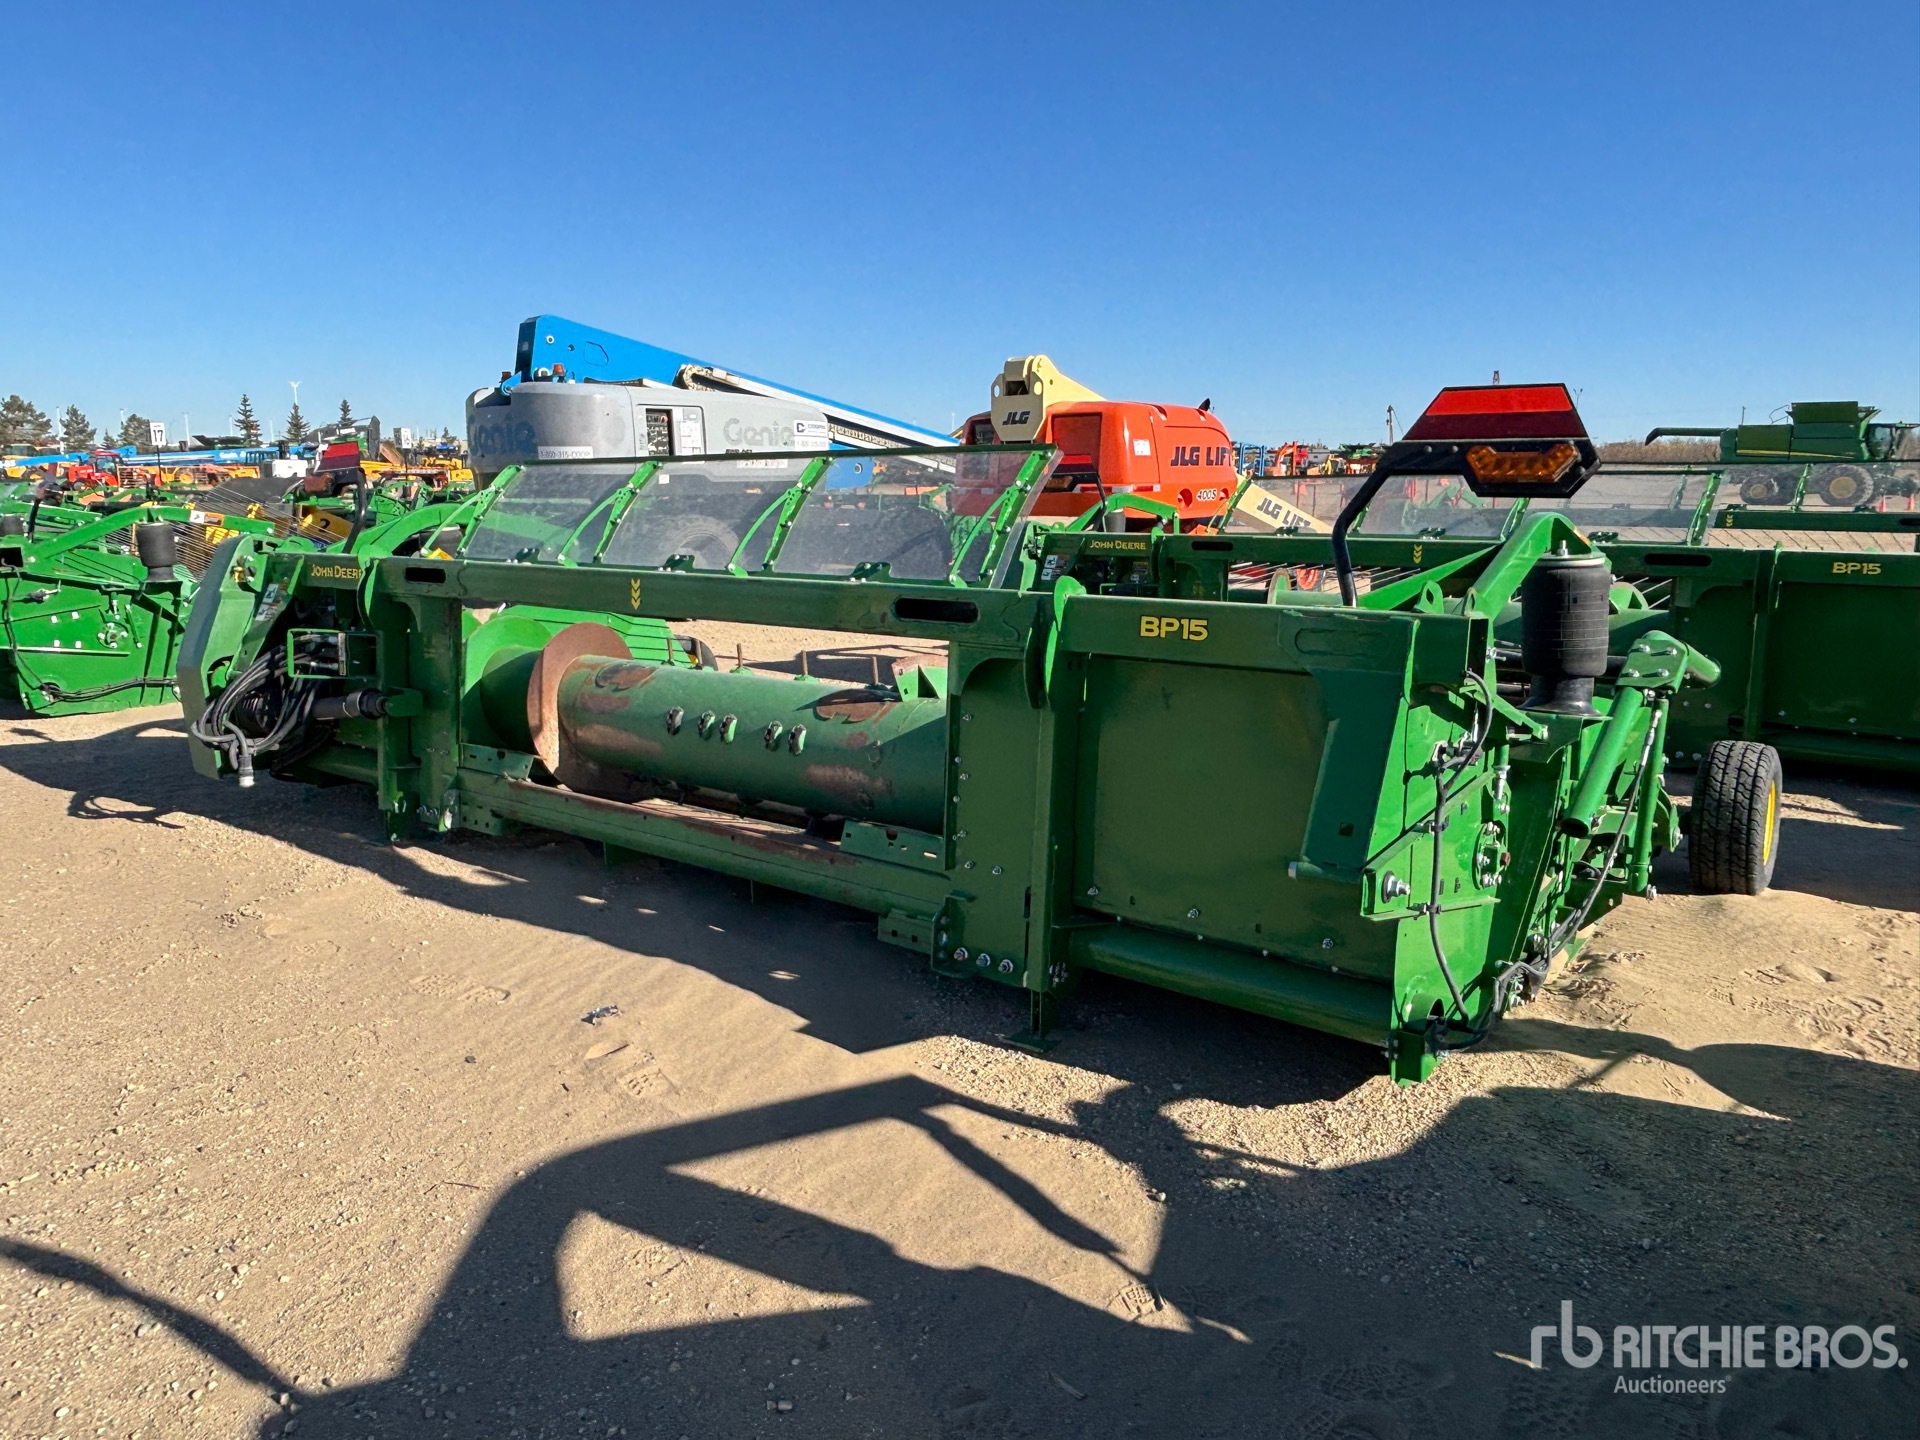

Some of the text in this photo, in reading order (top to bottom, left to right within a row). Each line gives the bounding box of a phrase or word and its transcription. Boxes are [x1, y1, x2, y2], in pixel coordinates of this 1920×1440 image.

[1002, 410, 1031, 426] JLG
[153, 429, 164, 442] 17
[1170, 446, 1200, 466] JLG
[1196, 488, 1217, 501] 400S
[1256, 497, 1283, 520] JLG
[1090, 540, 1146, 550] JOHN DEERE
[311, 564, 334, 577] JOHN
[1832, 561, 1882, 575] BP15
[1139, 615, 1209, 641] BP15
